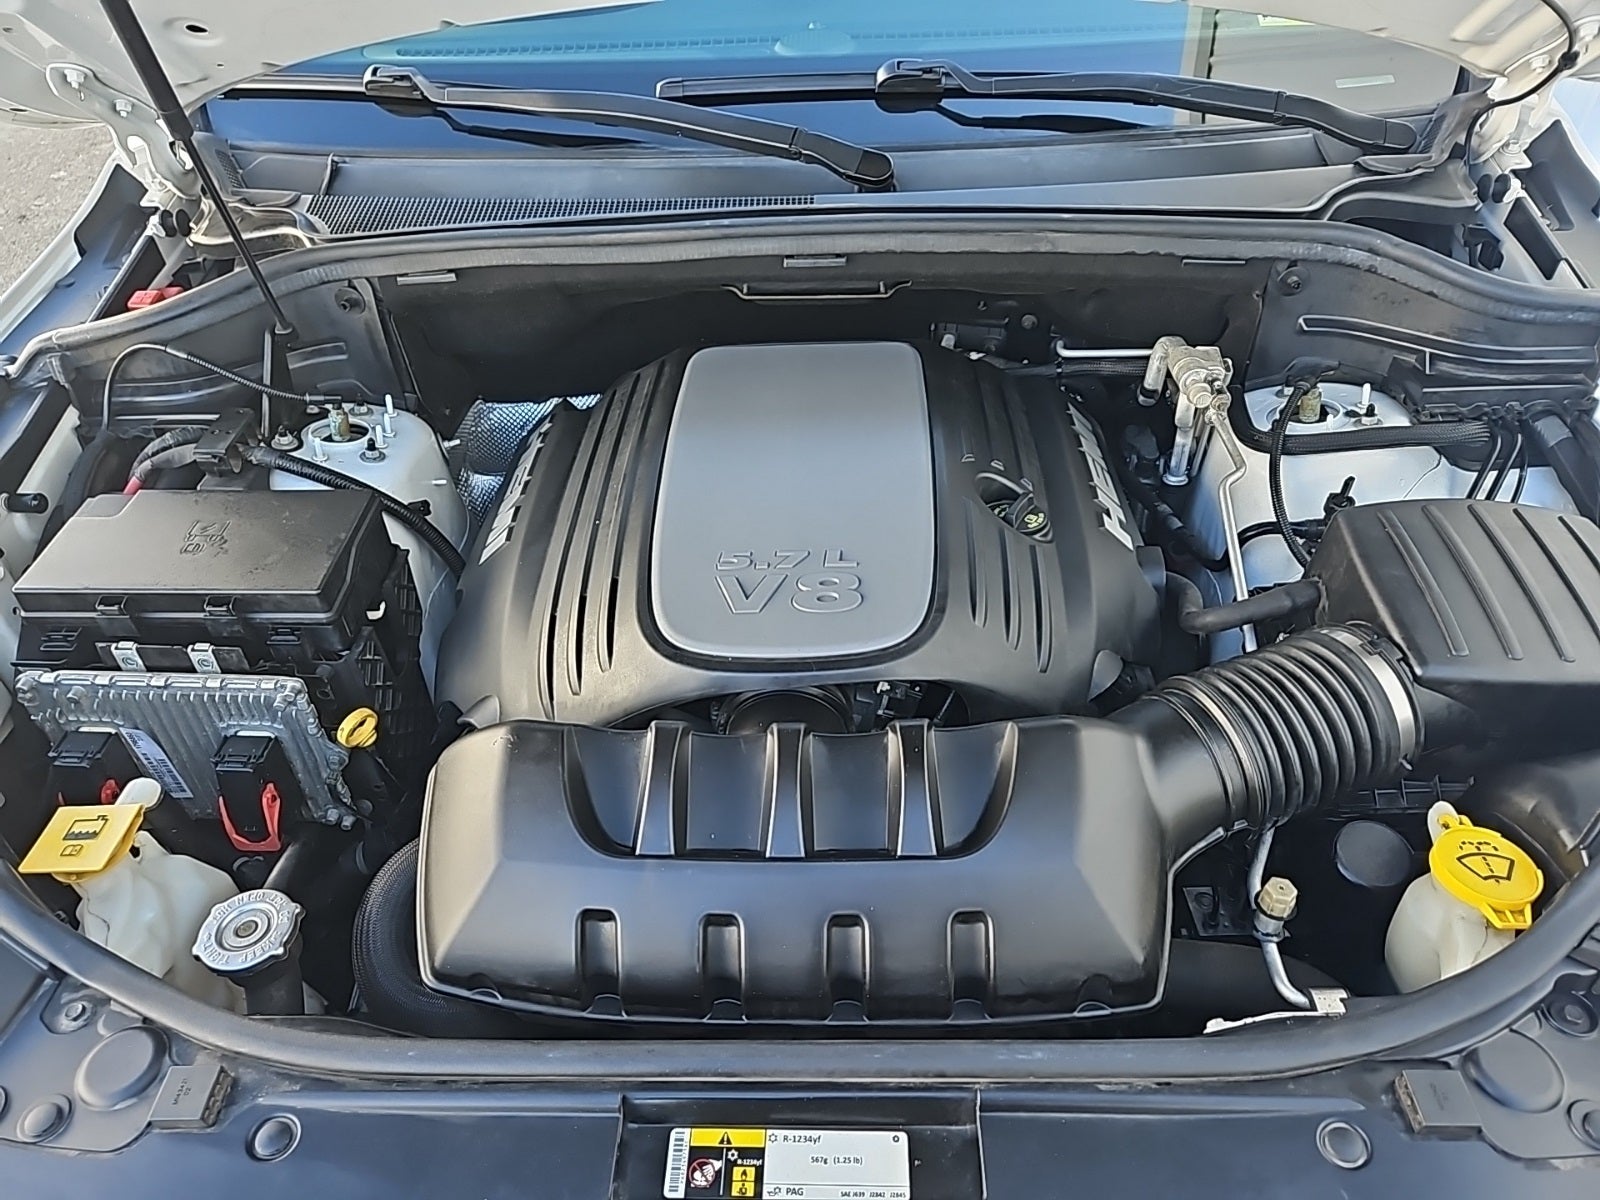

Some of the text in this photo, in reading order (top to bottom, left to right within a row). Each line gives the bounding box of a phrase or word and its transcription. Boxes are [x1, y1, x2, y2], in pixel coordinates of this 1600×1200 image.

[1066, 402, 1133, 551] HEMI
[714, 572, 864, 615] V8
[782, 1134, 821, 1145] R-1234yf
[810, 1156, 863, 1165] 567g (1.25 lb)
[785, 1187, 804, 1196] PAG
